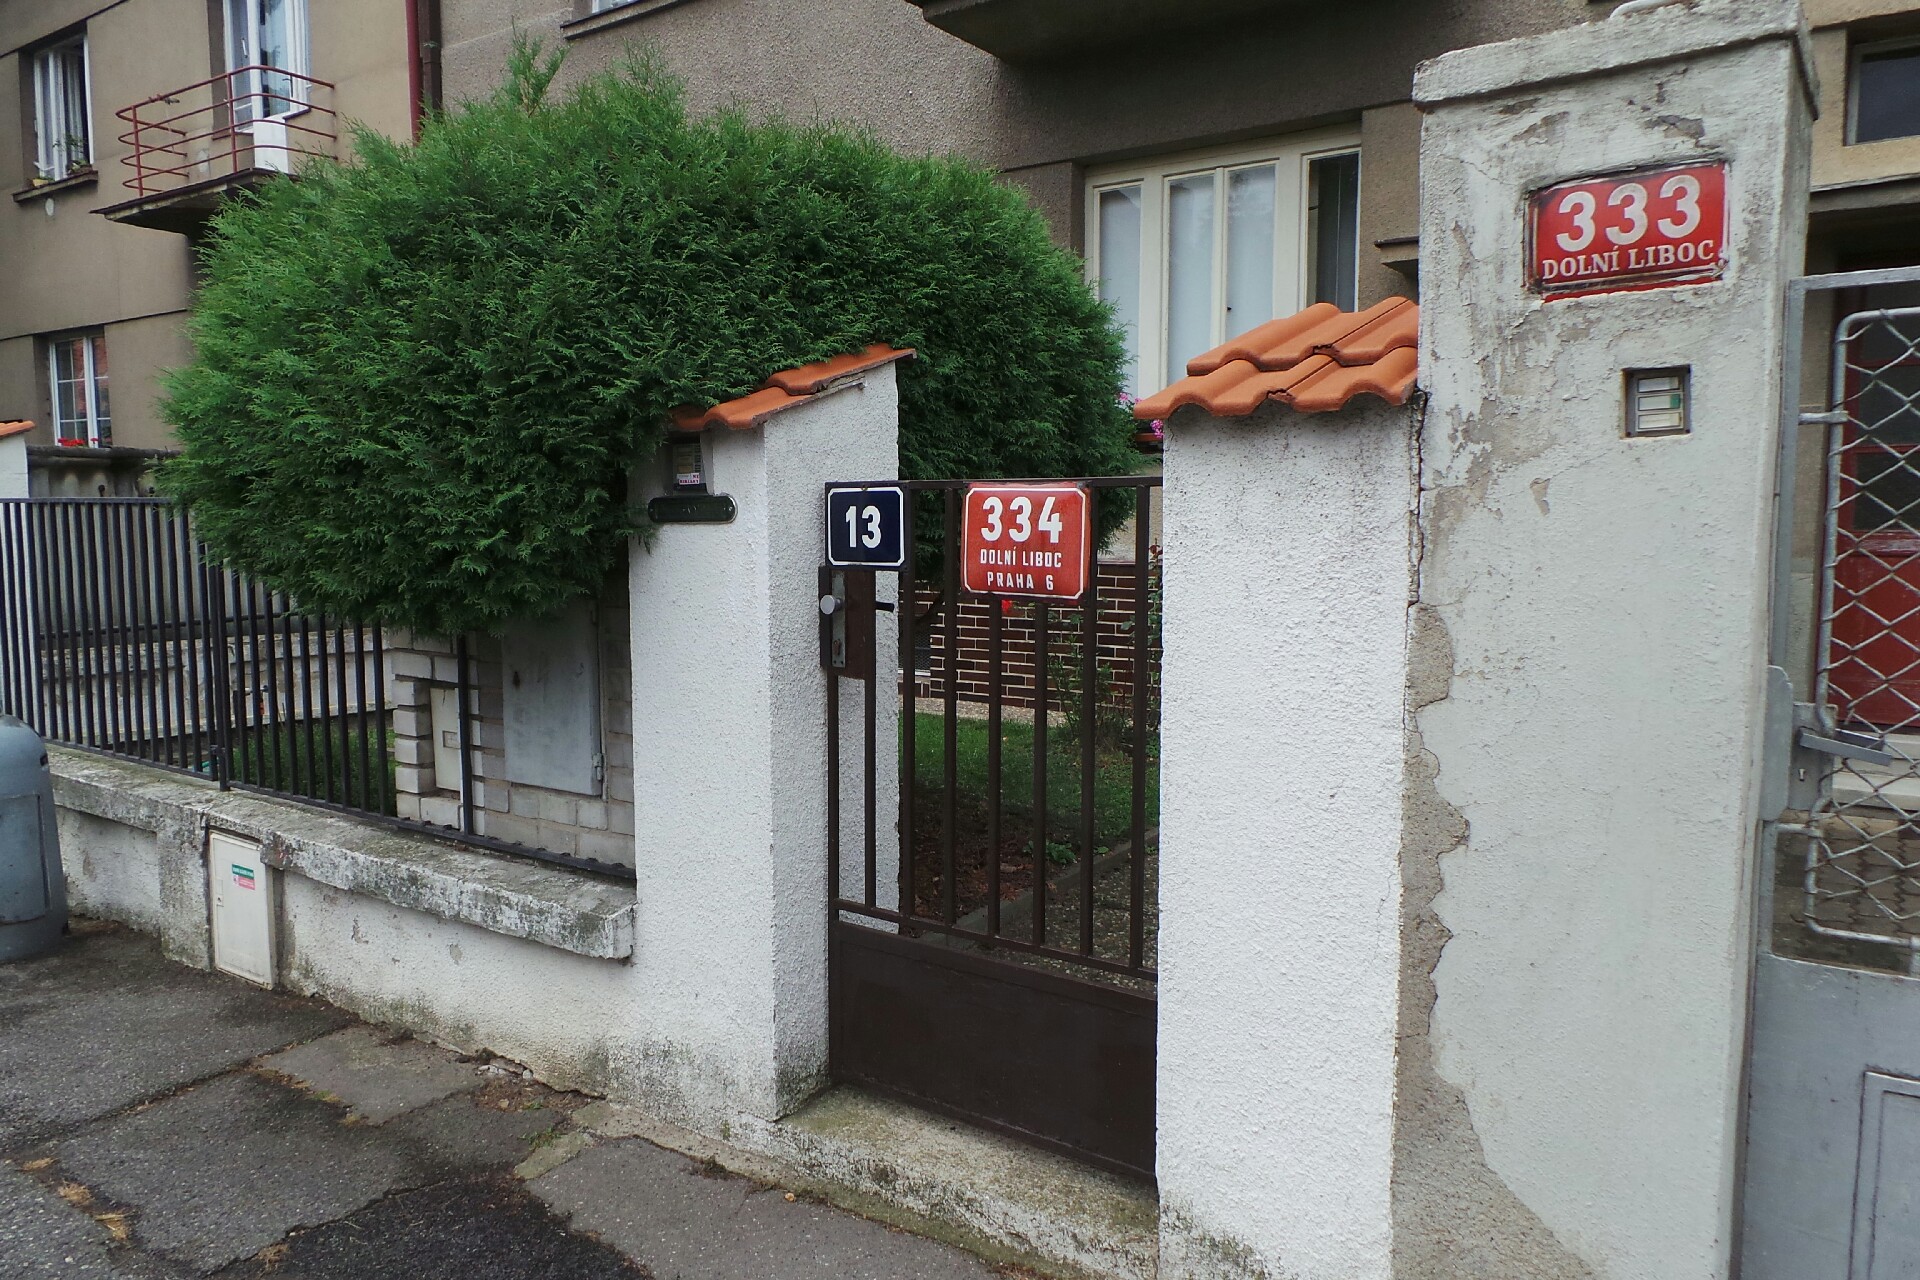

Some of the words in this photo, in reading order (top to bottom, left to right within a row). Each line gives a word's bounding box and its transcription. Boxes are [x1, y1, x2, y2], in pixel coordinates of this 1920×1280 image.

[1556, 174, 1701, 252] 333
[1542, 245, 1620, 280] DOLNÍ
[1628, 239, 1714, 269] LIBOC
[845, 505, 882, 548] 13
[980, 496, 1063, 543] 334
[980, 546, 1017, 565] DOLNÍ
[1022, 548, 1062, 568] LIBOC
[987, 571, 1034, 590] PRAHA
[1045, 574, 1054, 591] 6
